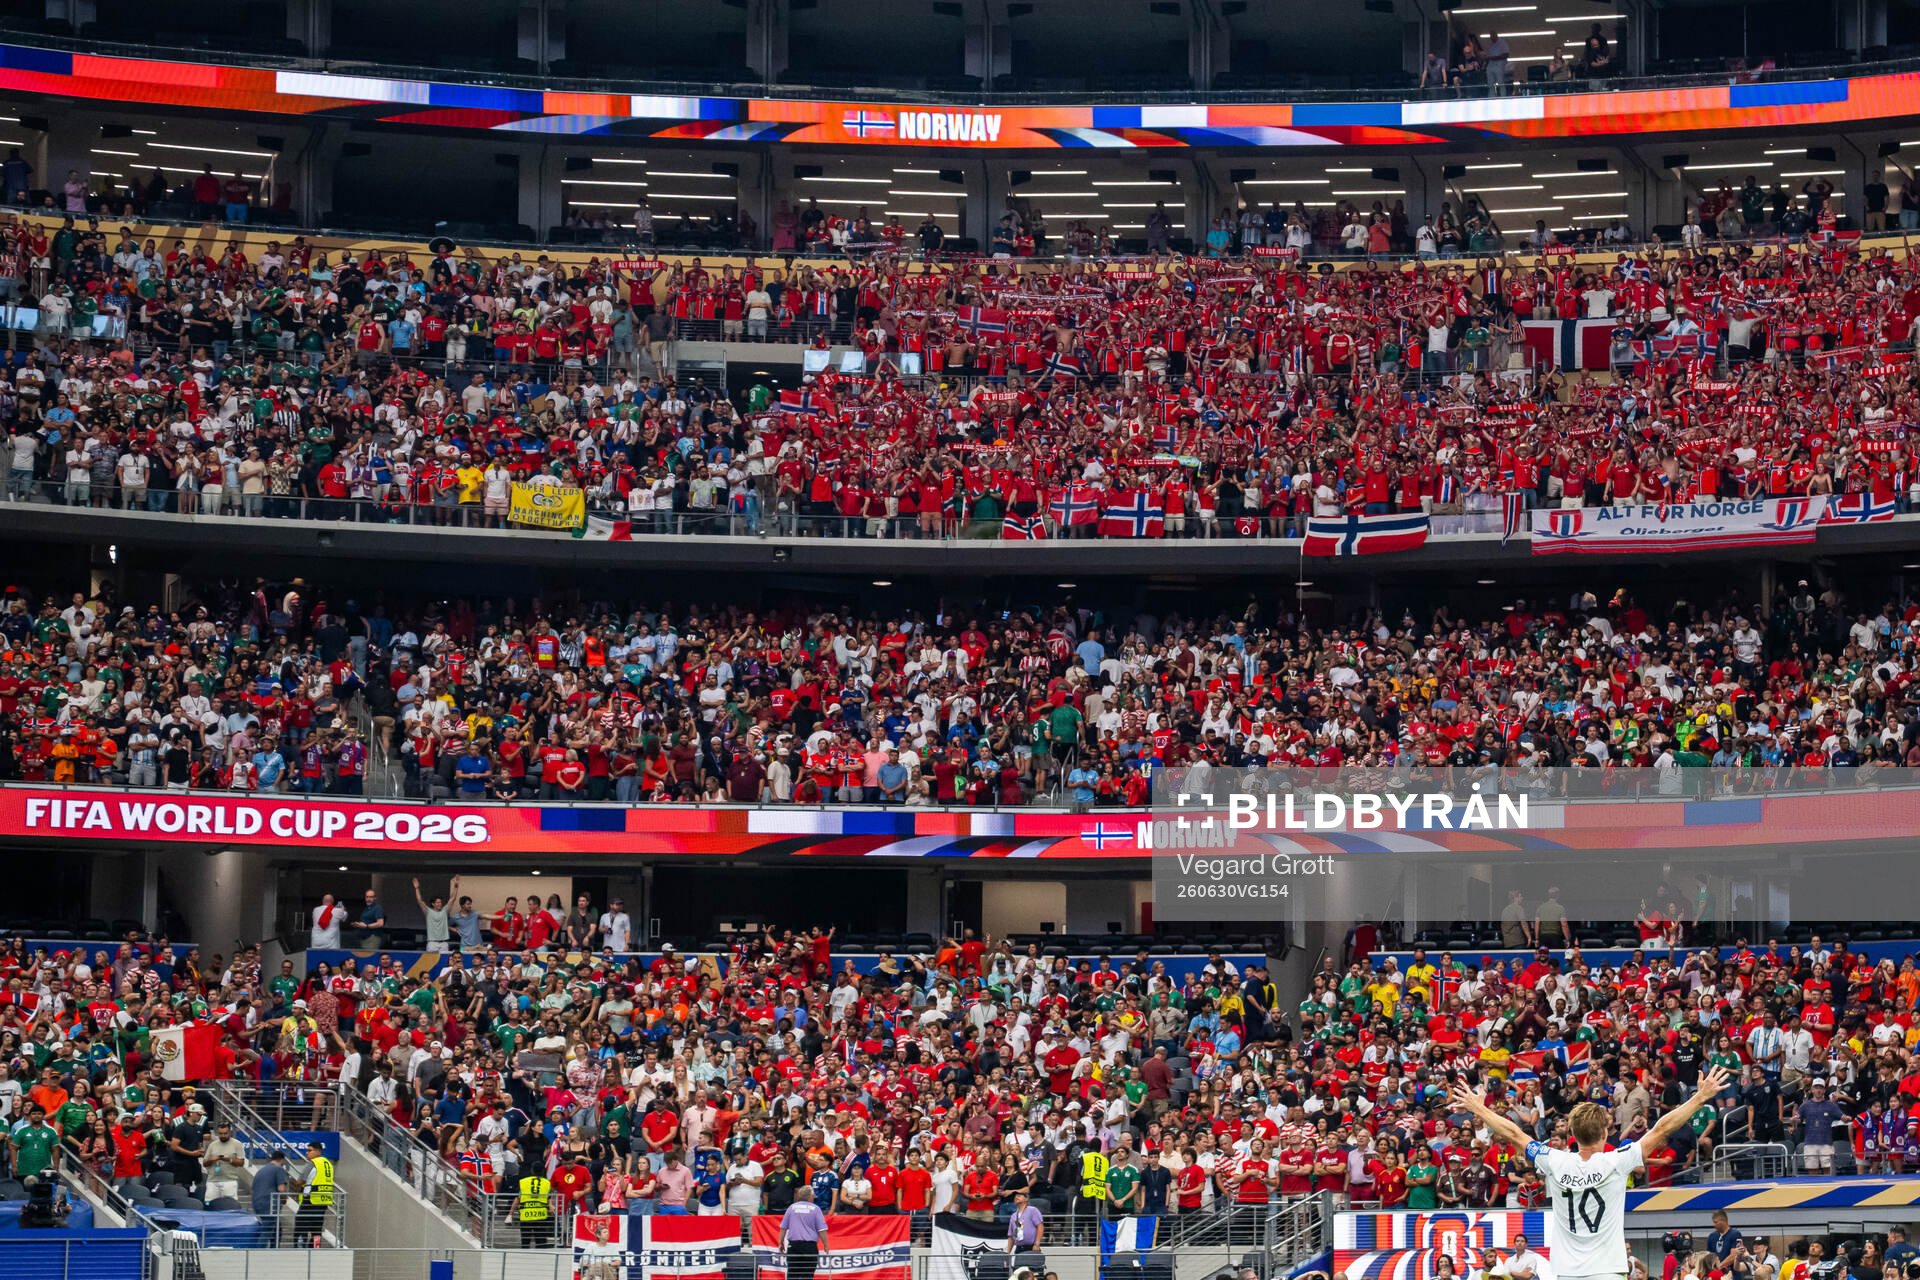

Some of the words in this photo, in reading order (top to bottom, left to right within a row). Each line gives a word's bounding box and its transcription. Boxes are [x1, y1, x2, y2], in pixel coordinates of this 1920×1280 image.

[899, 112, 1002, 141] NORWAY
[1191, 257, 1217, 266] NORGE
[552, 488, 580, 496] LEEDS
[1597, 505, 1632, 521] ALT
[1641, 504, 1685, 519] FOR
[1690, 500, 1764, 518] NORGE
[25, 798, 113, 829] FIFA
[118, 801, 264, 835] WORLD
[269, 808, 347, 839] CUP
[352, 812, 488, 843] 2026
[1137, 819, 1238, 849] NORWAY
[1561, 1186, 1606, 1233] 10
[816, 1249, 895, 1268] UGESUND
